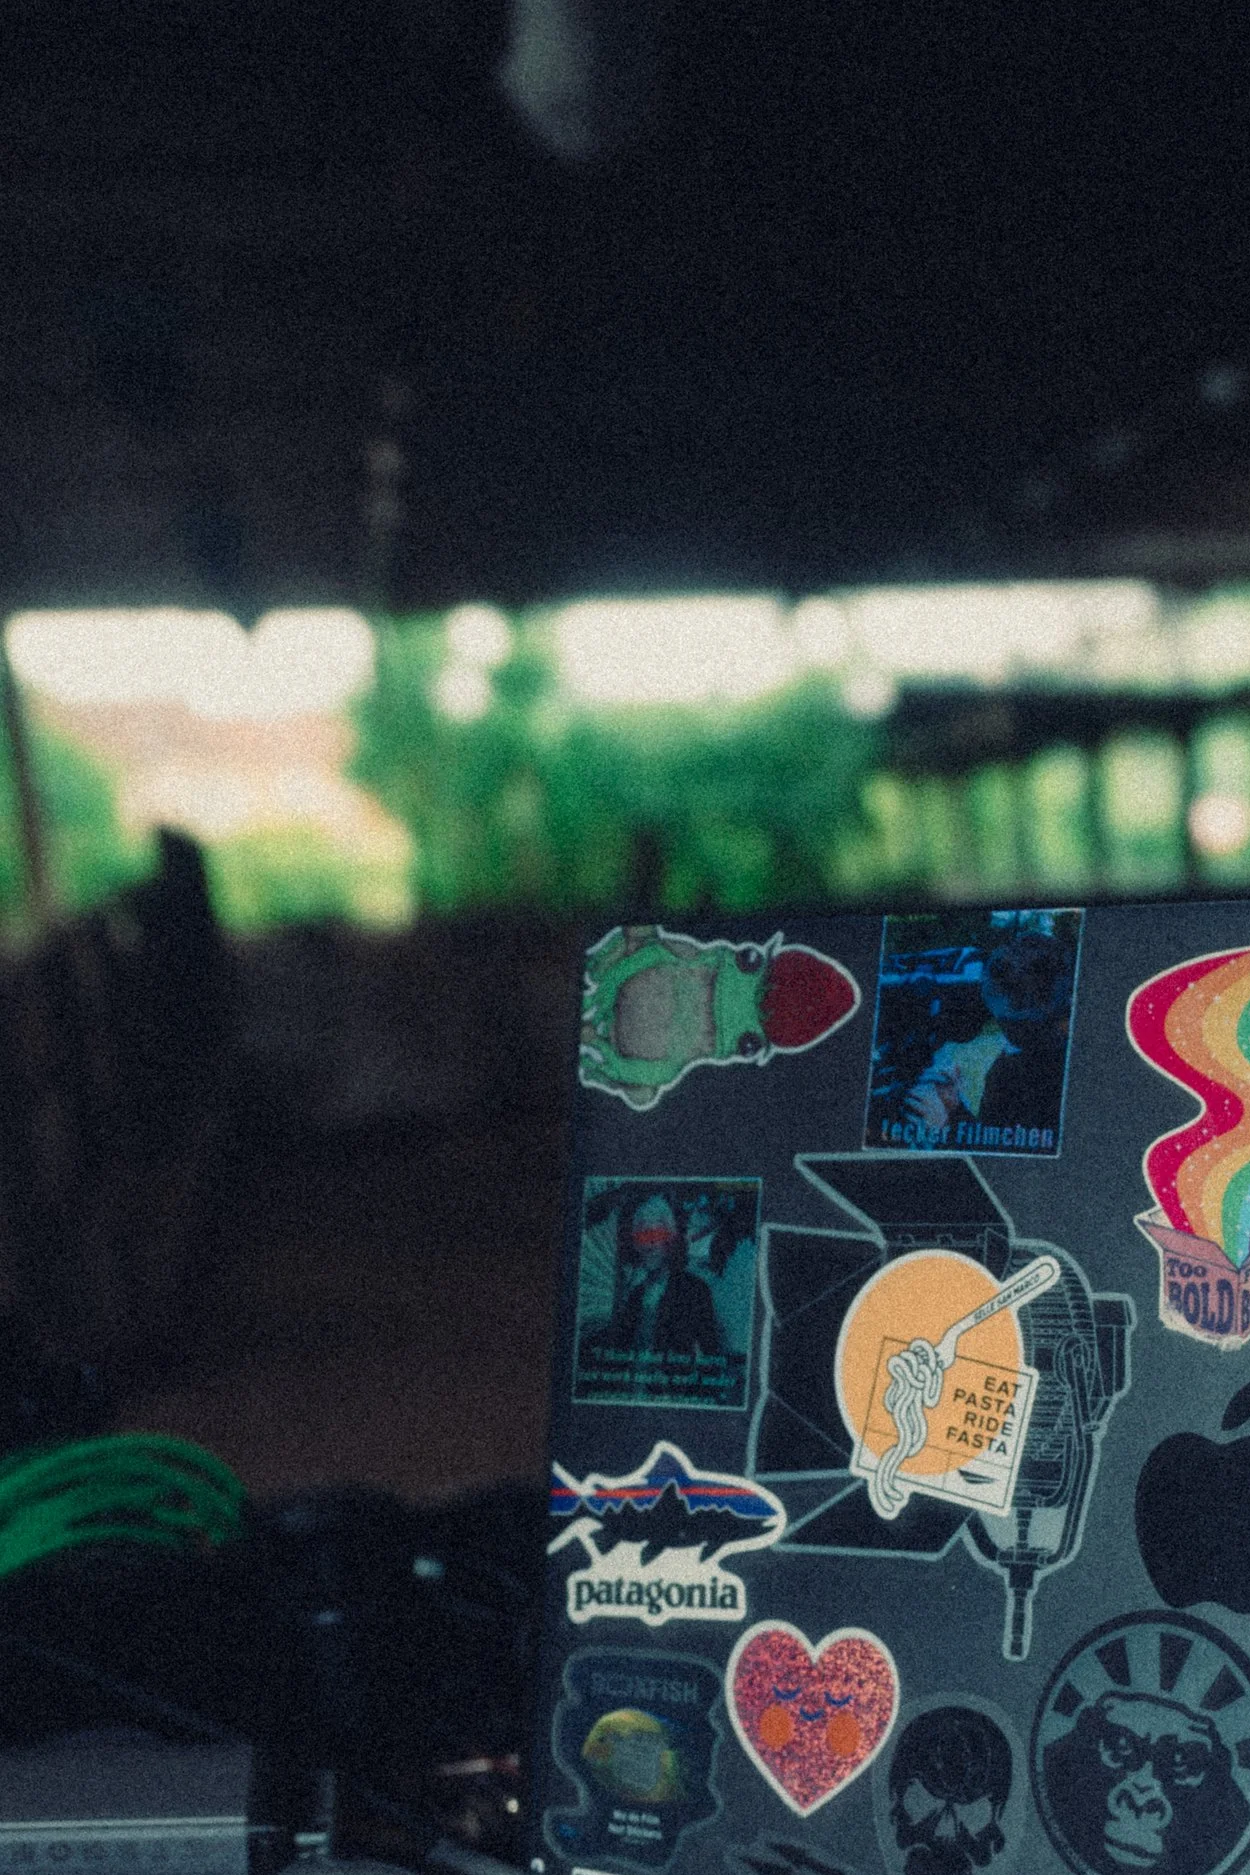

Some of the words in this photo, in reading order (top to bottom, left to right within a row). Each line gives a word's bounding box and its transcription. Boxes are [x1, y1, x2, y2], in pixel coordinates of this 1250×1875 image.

[1167, 1258, 1208, 1278] TOO
[1168, 1279, 1234, 1334] BOLD
[983, 1375, 1023, 1398] EAT
[952, 1387, 1016, 1418] PASTA
[963, 1410, 1014, 1437] RIDE
[945, 1425, 1008, 1456] FASTA
[575, 1576, 738, 1615] patagonia
